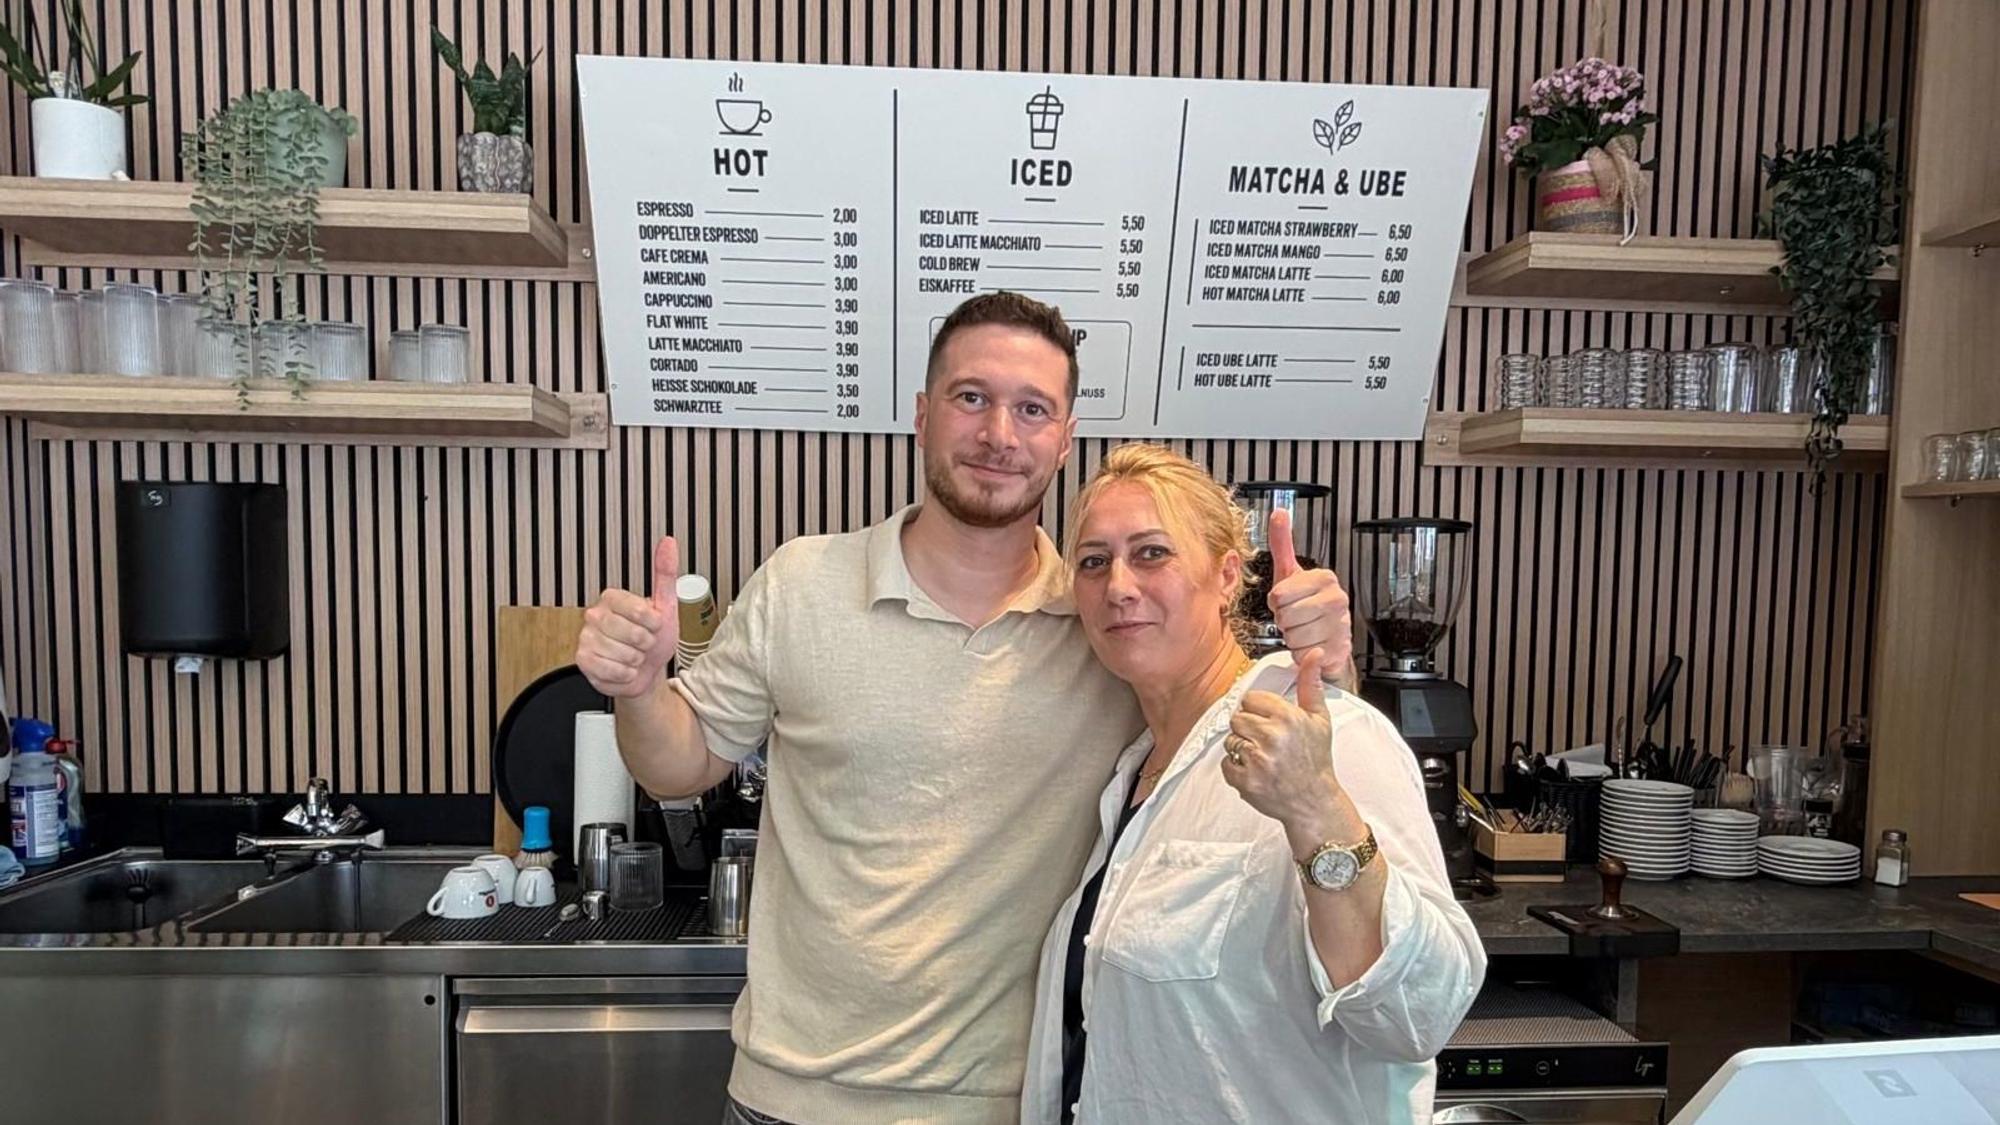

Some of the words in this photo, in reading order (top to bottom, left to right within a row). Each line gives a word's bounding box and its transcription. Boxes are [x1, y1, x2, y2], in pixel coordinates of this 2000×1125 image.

[713, 148, 768, 177] HOT
[1011, 158, 1072, 187] ICED
[1229, 166, 1325, 195] MATCHA
[1334, 168, 1349, 196] &
[1359, 169, 1407, 197] UBE
[637, 201, 694, 218] ESPRESSO
[833, 208, 857, 225] 2,00
[920, 209, 944, 225] ICED
[946, 210, 979, 226] LATTE
[1121, 215, 1145, 233] 5,50
[639, 224, 701, 242] DOPPELTER
[702, 226, 758, 244] ESPRESSO
[834, 232, 857, 248] 3,00
[1209, 219, 1235, 235] ICED
[1237, 220, 1282, 237] MATCHA
[1284, 221, 1358, 238] STRAWBERRY
[1388, 224, 1412, 241] 6,50
[920, 233, 944, 248] ICED
[945, 234, 978, 249] LATTE
[980, 235, 1041, 251] MACCHIATO
[1120, 239, 1143, 256] 5,50
[1207, 242, 1233, 257] ICED
[1234, 243, 1279, 259] MATCHA
[1281, 244, 1321, 259] MANGO
[1385, 247, 1408, 263] 6,50
[640, 248, 669, 263] CAFE
[670, 248, 709, 264] CREMA
[834, 254, 857, 271] 3,00
[919, 255, 947, 271] COLD
[949, 256, 981, 272] BREW
[1118, 261, 1141, 277] 5,50
[643, 270, 706, 287] AMERICANO
[835, 276, 858, 293] 3,00
[1204, 264, 1230, 279] ICED
[1231, 265, 1276, 280] MATCHA
[1278, 266, 1312, 281] LATTE
[1381, 269, 1404, 285] 6,00
[919, 278, 976, 293] EISKAFFEE
[1116, 283, 1139, 299] 5,50
[1202, 286, 1225, 300] HOT
[1226, 287, 1270, 301] MATCHA
[1272, 288, 1306, 302] LATTE
[1377, 290, 1400, 306] 6,00
[644, 292, 713, 309] CAPPUCCINO
[835, 298, 858, 314] 3,90
[646, 314, 672, 329] FLAT
[673, 315, 708, 330] WHITE
[835, 320, 858, 337] 3,90
[648, 336, 681, 351] LATTE
[682, 337, 742, 353] MACCHIATO
[836, 342, 858, 358] 3,90
[650, 357, 698, 372] CORTADO
[836, 363, 859, 378] 3,90
[1196, 353, 1221, 367] ICED
[1223, 353, 1244, 367] UBE
[1245, 354, 1278, 368] LATTE
[1368, 356, 1390, 371] 5,50
[652, 378, 689, 393] HEISSE
[690, 379, 758, 395] SCHOKOLADE
[837, 384, 859, 399] 3,50
[1194, 373, 1216, 387] HOT
[1217, 373, 1239, 387] UBE
[1240, 374, 1272, 388] LATTE
[1365, 376, 1387, 391] 5,50
[653, 399, 723, 414] SCHWARZTEE
[837, 404, 859, 419] 2,00
